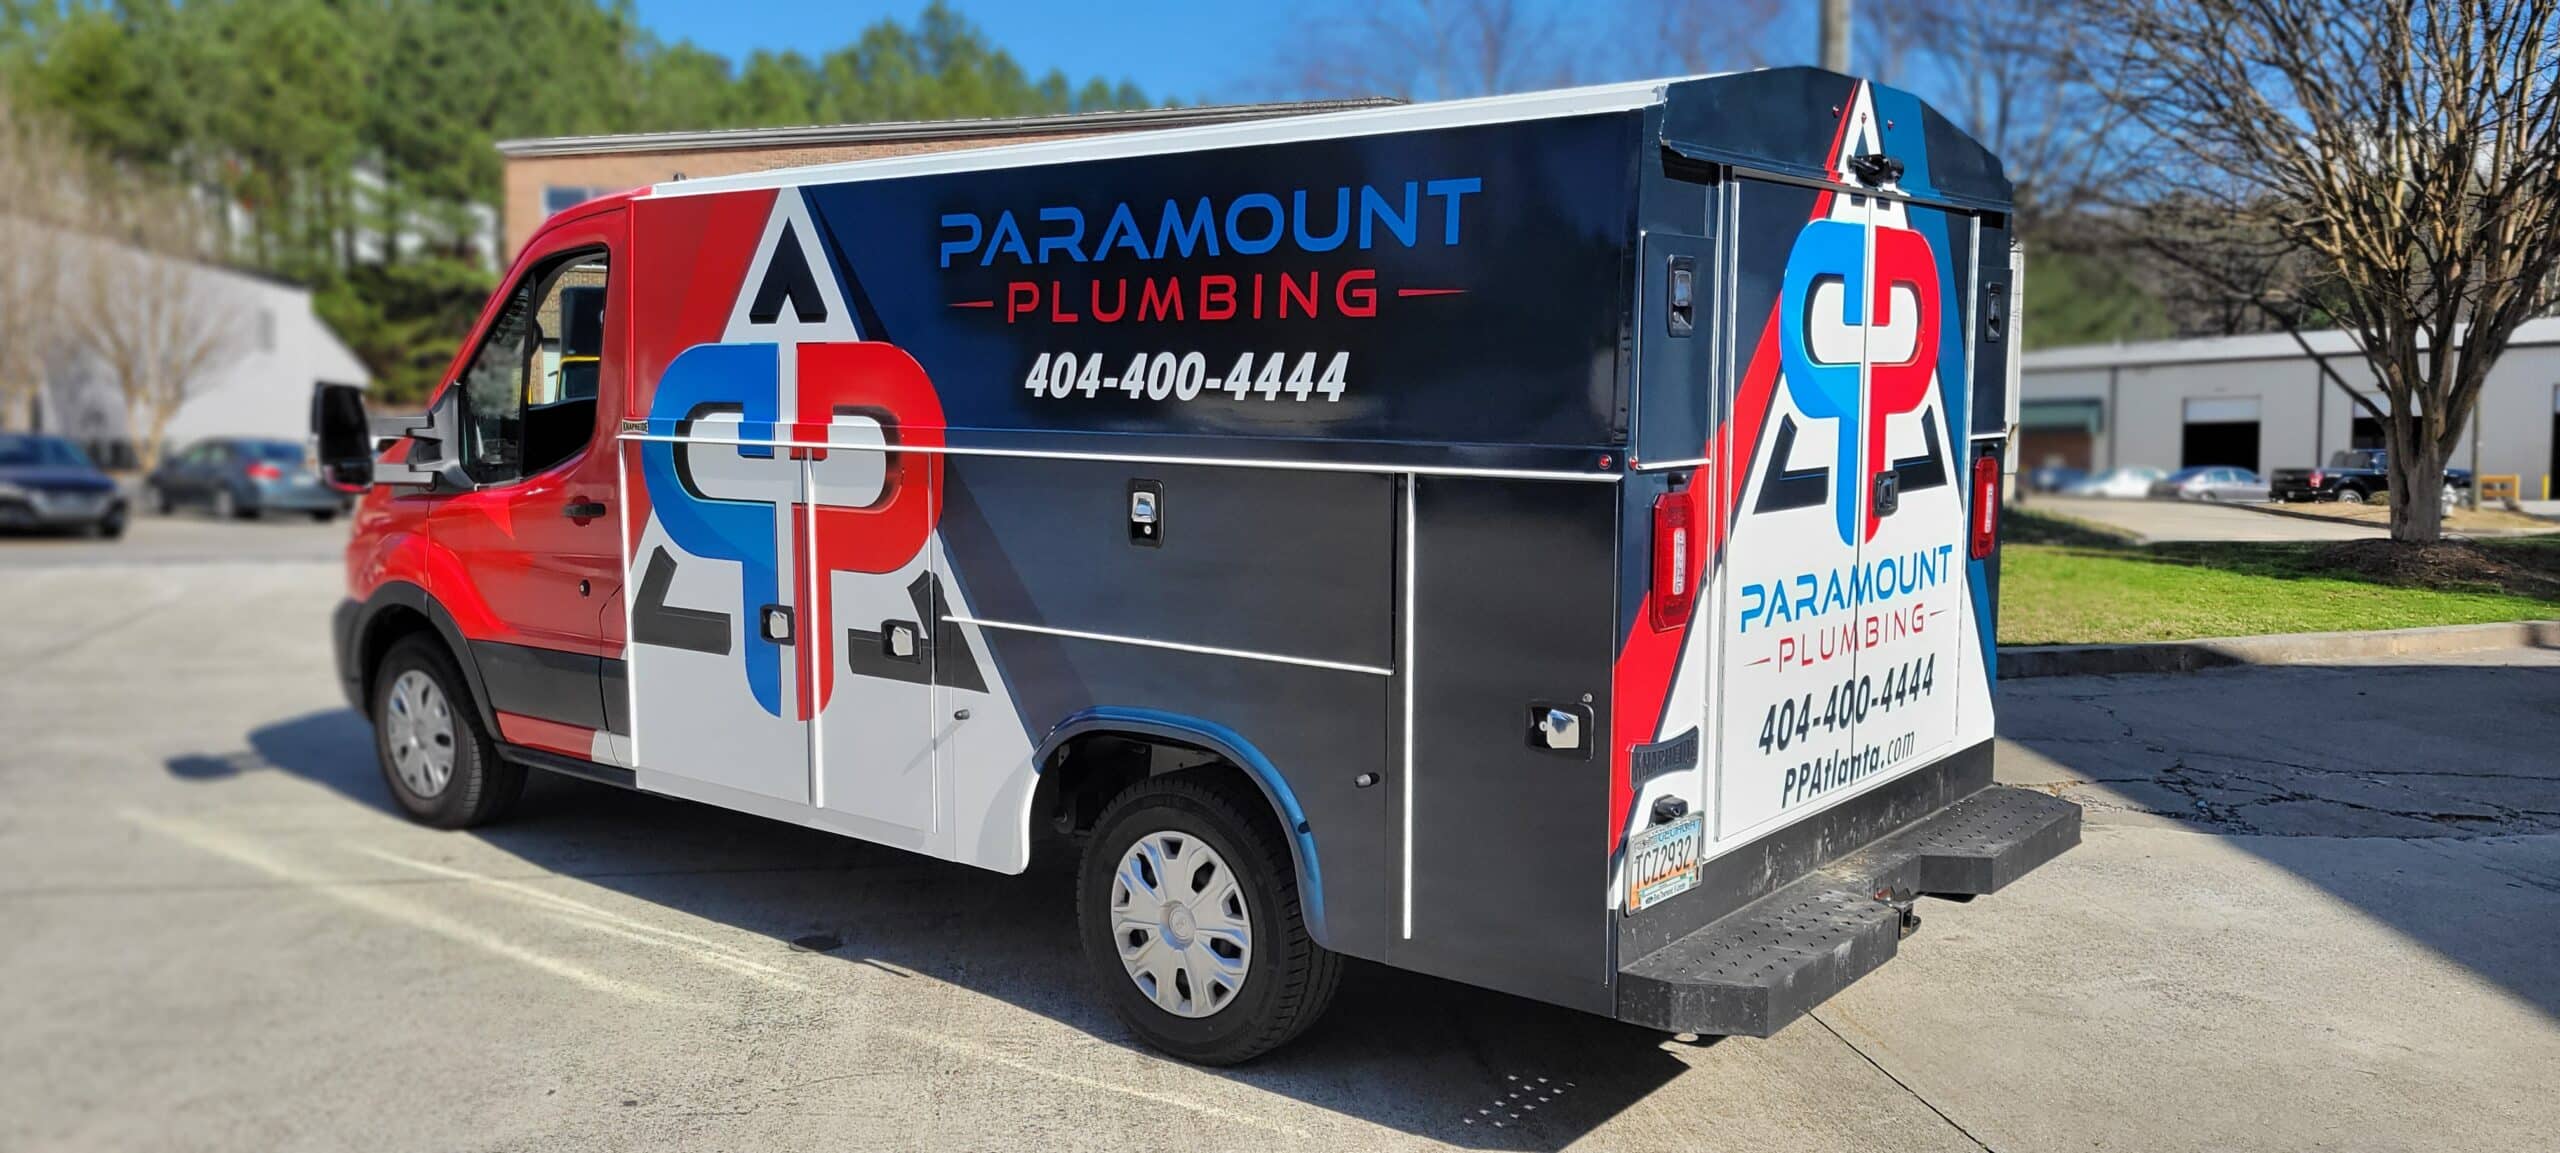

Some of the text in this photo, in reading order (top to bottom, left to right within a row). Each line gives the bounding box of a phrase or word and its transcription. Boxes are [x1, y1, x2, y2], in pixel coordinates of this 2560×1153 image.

[940, 177, 1482, 268] PARAMOUNT
[1007, 269, 1377, 323] PLUMBING
[1024, 351, 1350, 402] 404-400-4444
[1740, 544, 1953, 633] PARAMOUNT
[1778, 602, 1925, 673] PLUMBING
[1758, 653, 1935, 755] 404-400-4444
[1781, 730, 1915, 808] PPAtlanta.com
[1635, 834, 1692, 889] TCZ2932
